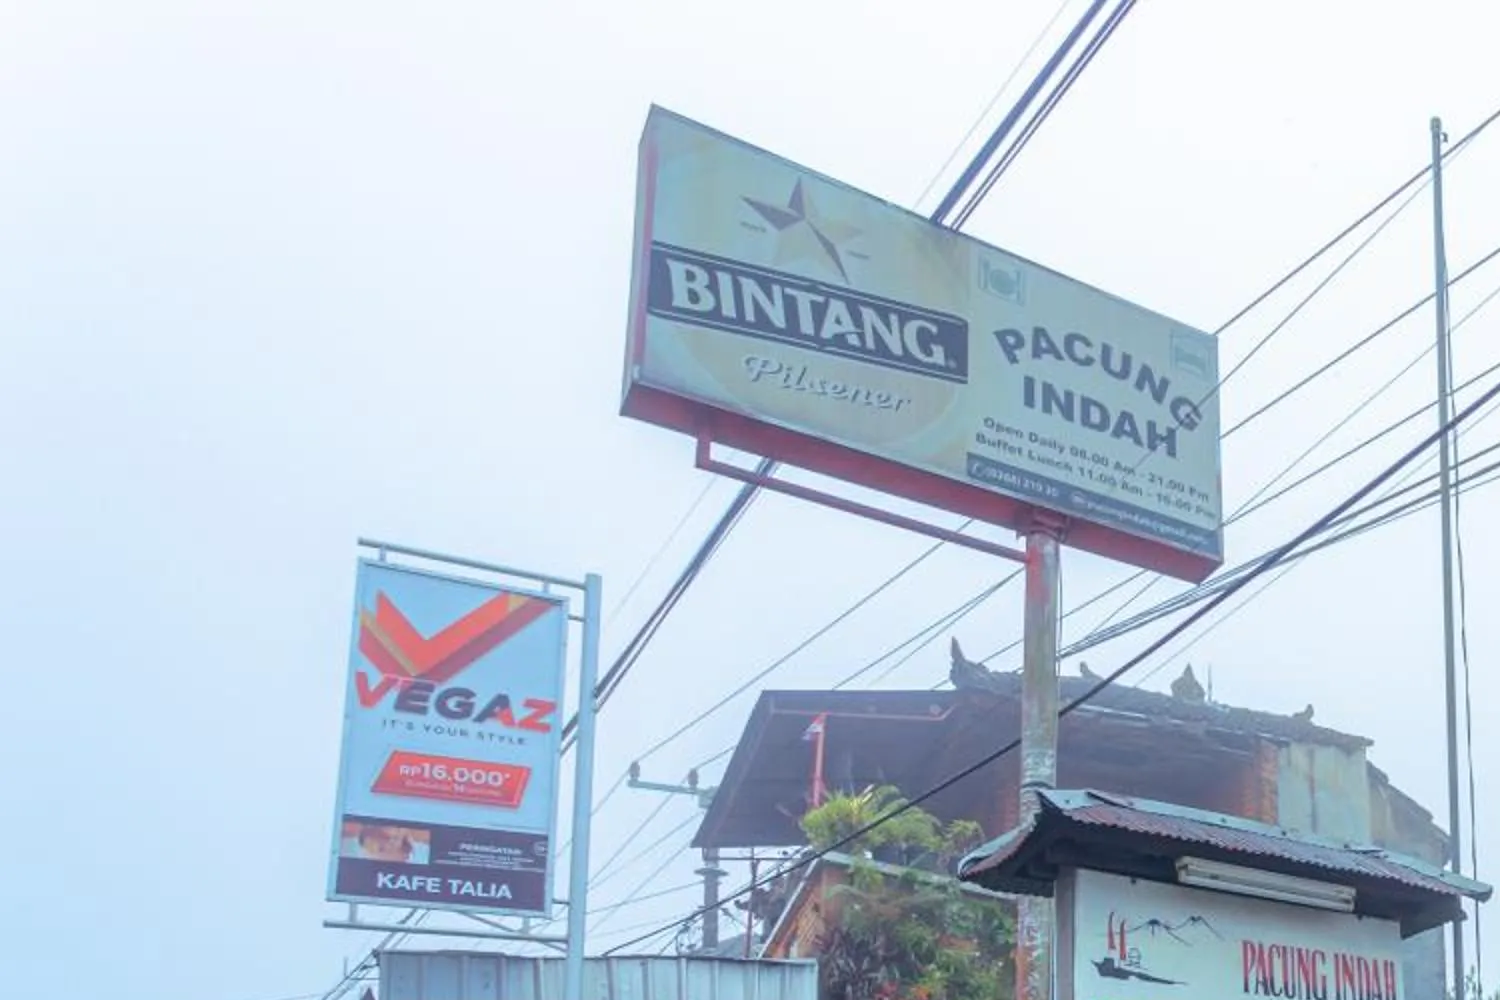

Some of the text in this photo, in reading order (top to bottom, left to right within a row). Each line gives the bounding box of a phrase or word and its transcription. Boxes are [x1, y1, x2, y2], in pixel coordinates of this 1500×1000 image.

[666, 256, 948, 369] BINTANG
[743, 353, 912, 412] Pilsener
[993, 326, 1203, 431] PACUNG
[983, 416, 1023, 440] Open
[1029, 431, 1065, 455] Daily
[1023, 375, 1177, 459] INDAH
[976, 432, 1023, 457] Buffet
[1028, 446, 1073, 474] Lunch
[355, 671, 557, 733] VEGAZ
[382, 718, 527, 746] IT'S YOUR STYLE
[377, 871, 512, 900] KAFE TALIA
